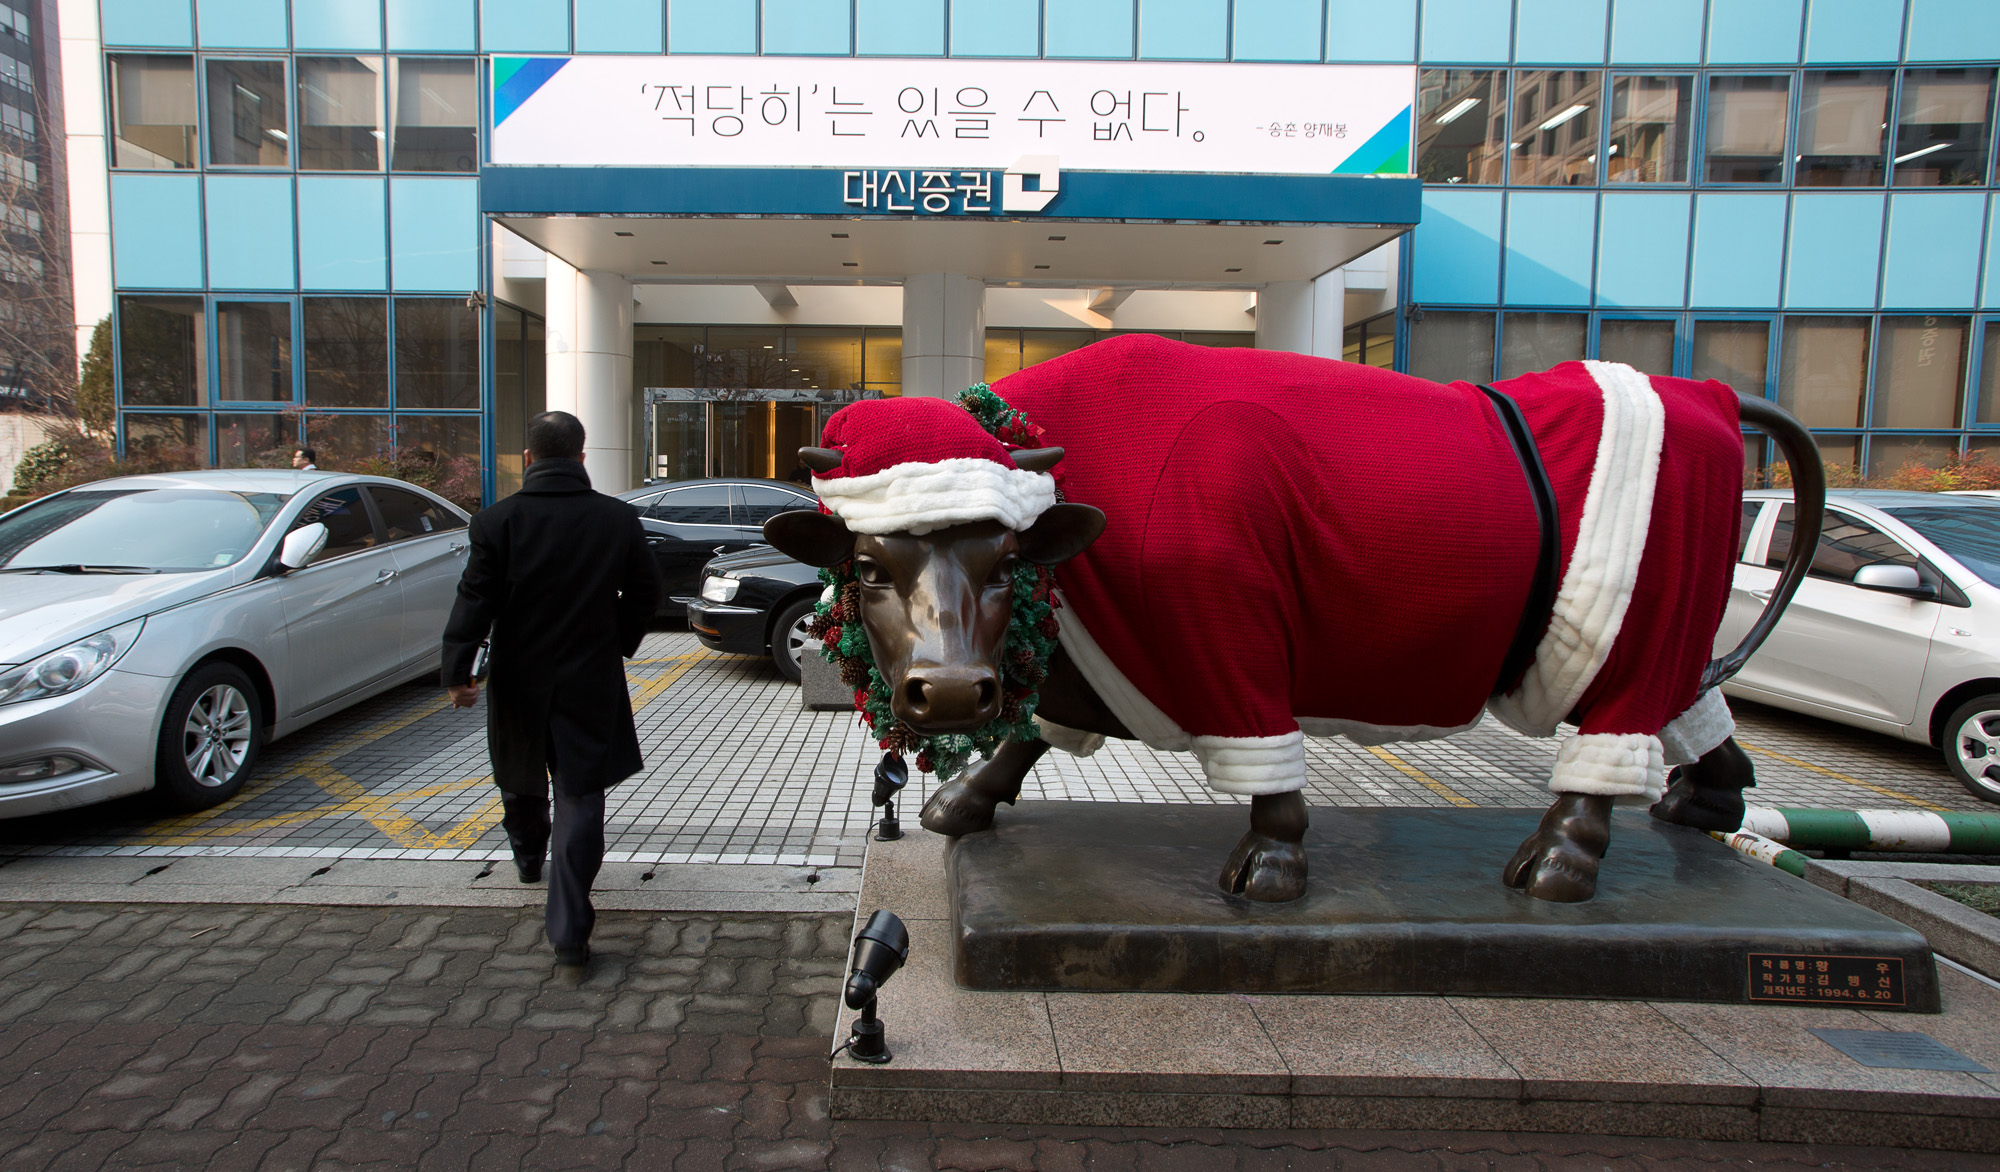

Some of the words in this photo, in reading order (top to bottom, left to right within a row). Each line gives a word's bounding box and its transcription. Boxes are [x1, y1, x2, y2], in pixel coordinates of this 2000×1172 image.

[897, 86, 997, 139] 있을
[1017, 90, 1067, 138] 수
[1268, 121, 1298, 138] 송촌
[1303, 122, 1348, 139] 양재봉
[842, 169, 993, 212] 대신증권
